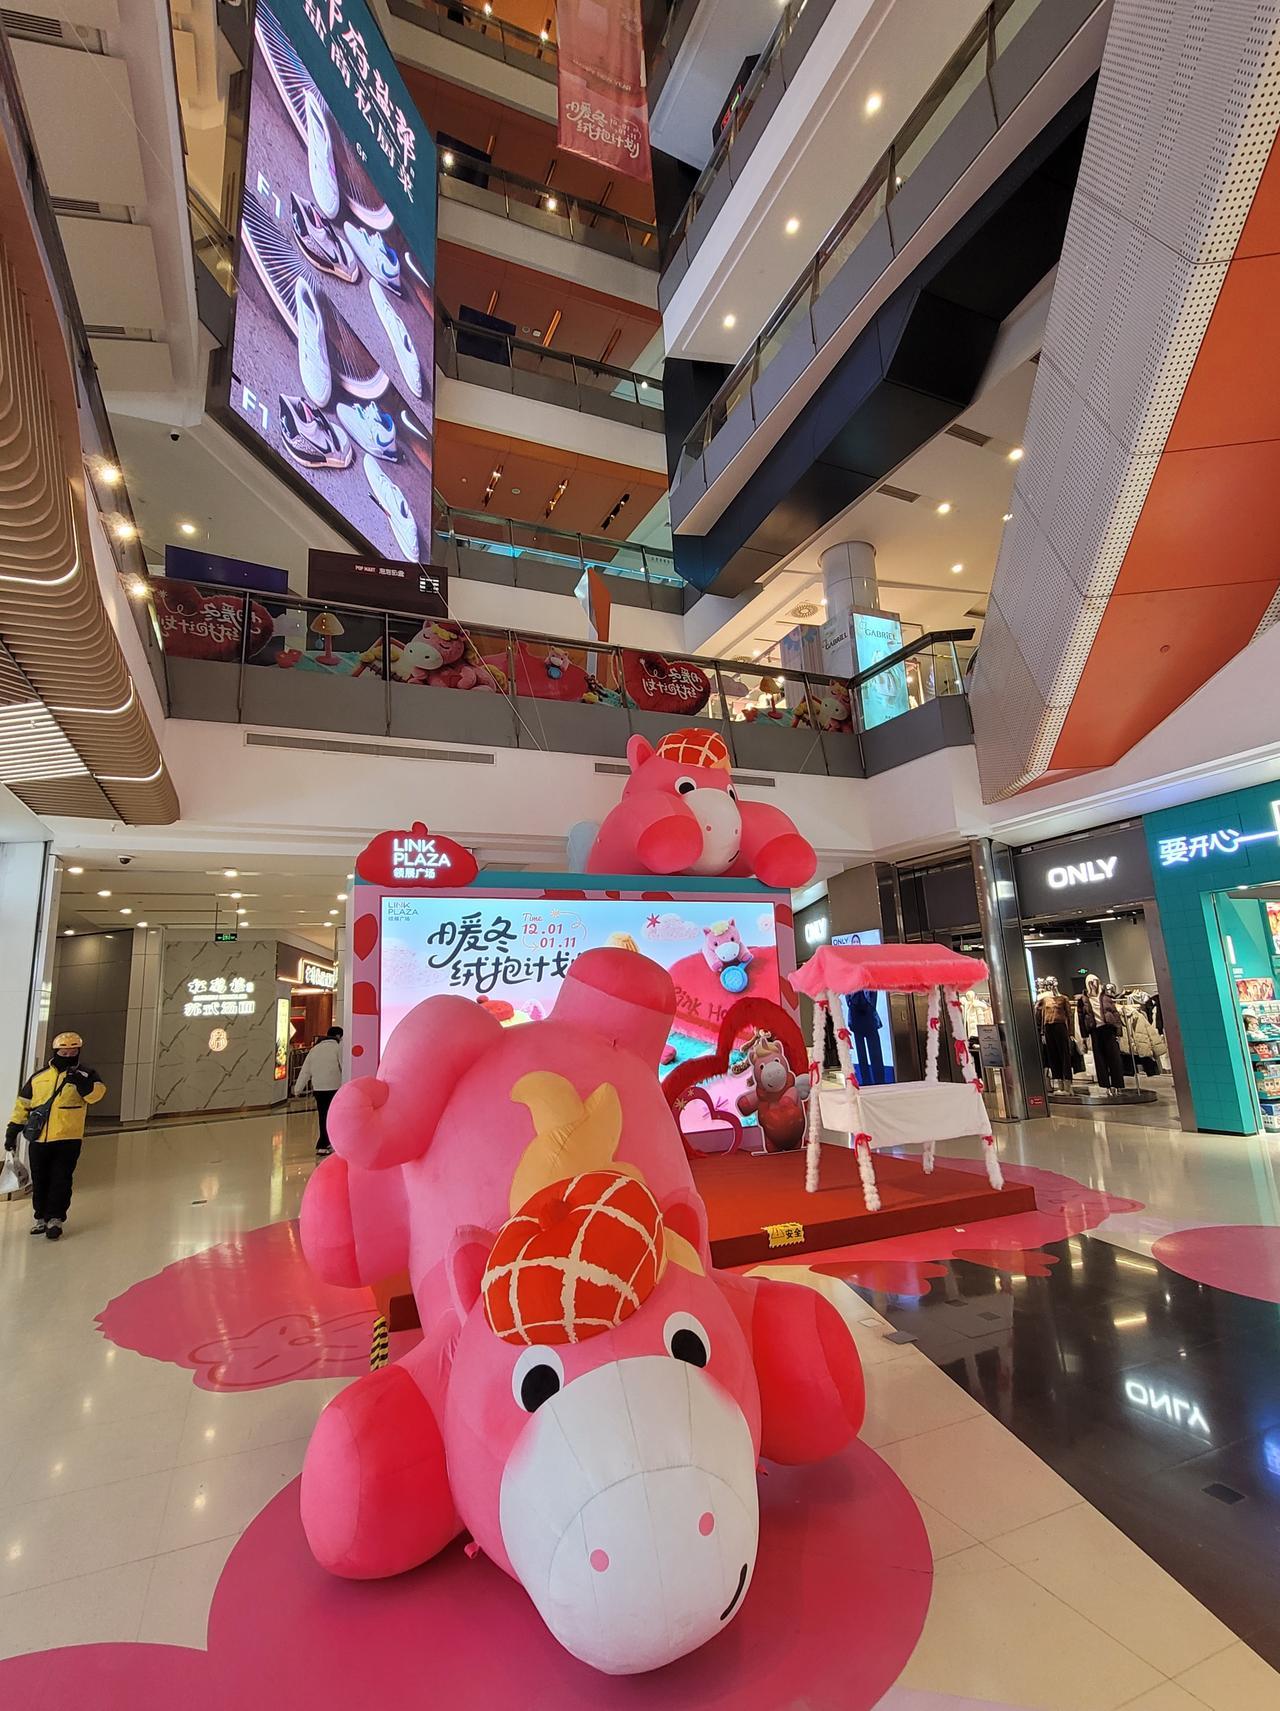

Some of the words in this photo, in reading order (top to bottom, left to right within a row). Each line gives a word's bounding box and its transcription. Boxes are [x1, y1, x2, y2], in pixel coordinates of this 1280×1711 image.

[393, 838, 436, 852] LINK
[1159, 829, 1240, 866] 要开心
[393, 852, 451, 867] PLAZA
[1048, 855, 1118, 889] ONLY
[427, 911, 517, 969] 暖冬
[833, 937, 849, 946] ONLY
[785, 1228, 801, 1239] 安全
